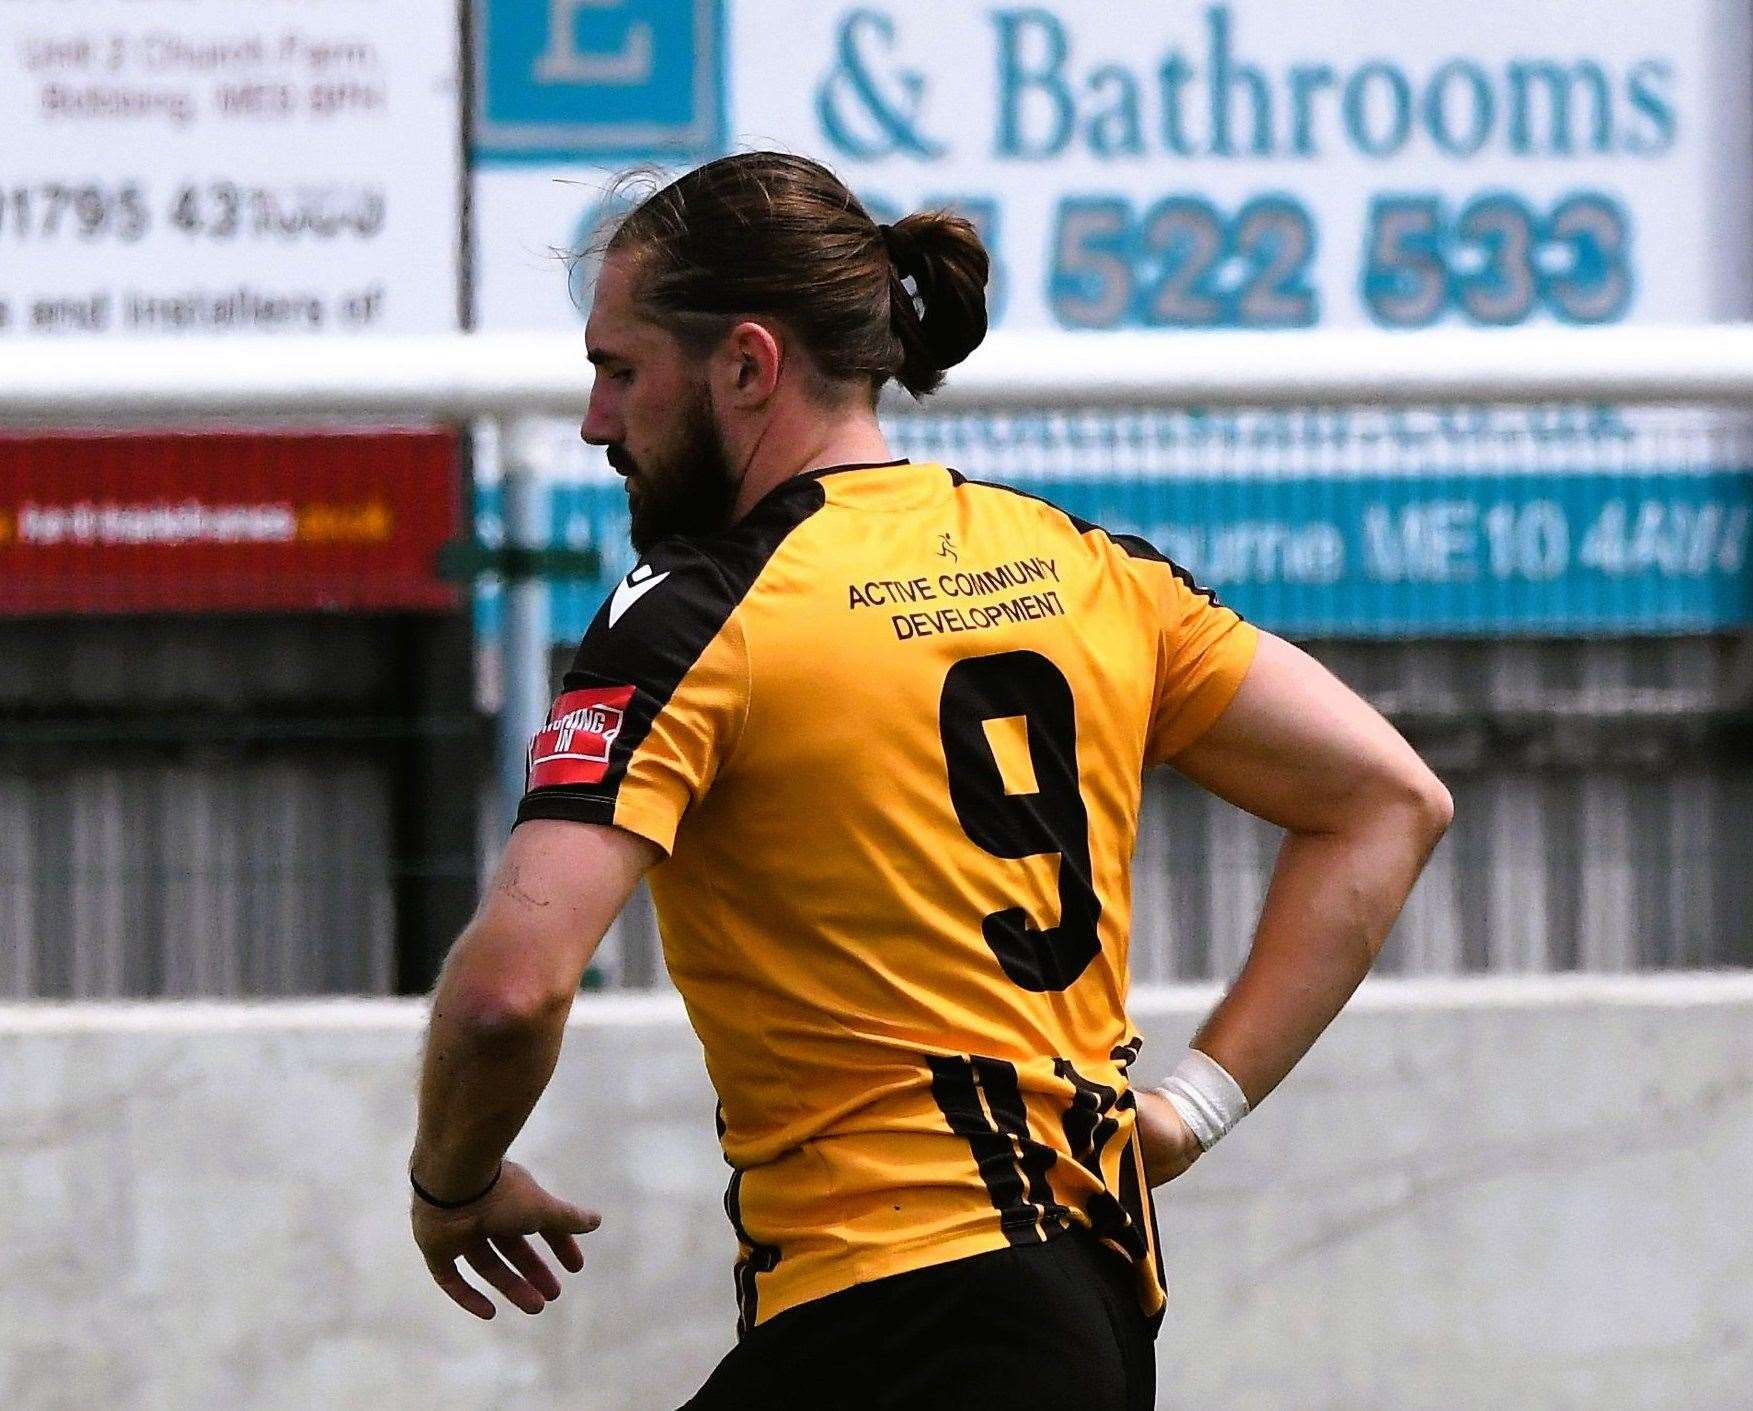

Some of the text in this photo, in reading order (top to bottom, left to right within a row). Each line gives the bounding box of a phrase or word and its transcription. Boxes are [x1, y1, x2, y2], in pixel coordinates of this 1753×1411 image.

[816, 5, 1677, 159] & Bathrooms
[1050, 194, 1319, 330] 522
[1362, 192, 1634, 328] 533
[849, 557, 1060, 610] ACTIVE COMMUNY
[891, 591, 1065, 641] DEVELOPMENT
[939, 649, 1103, 993] 9
